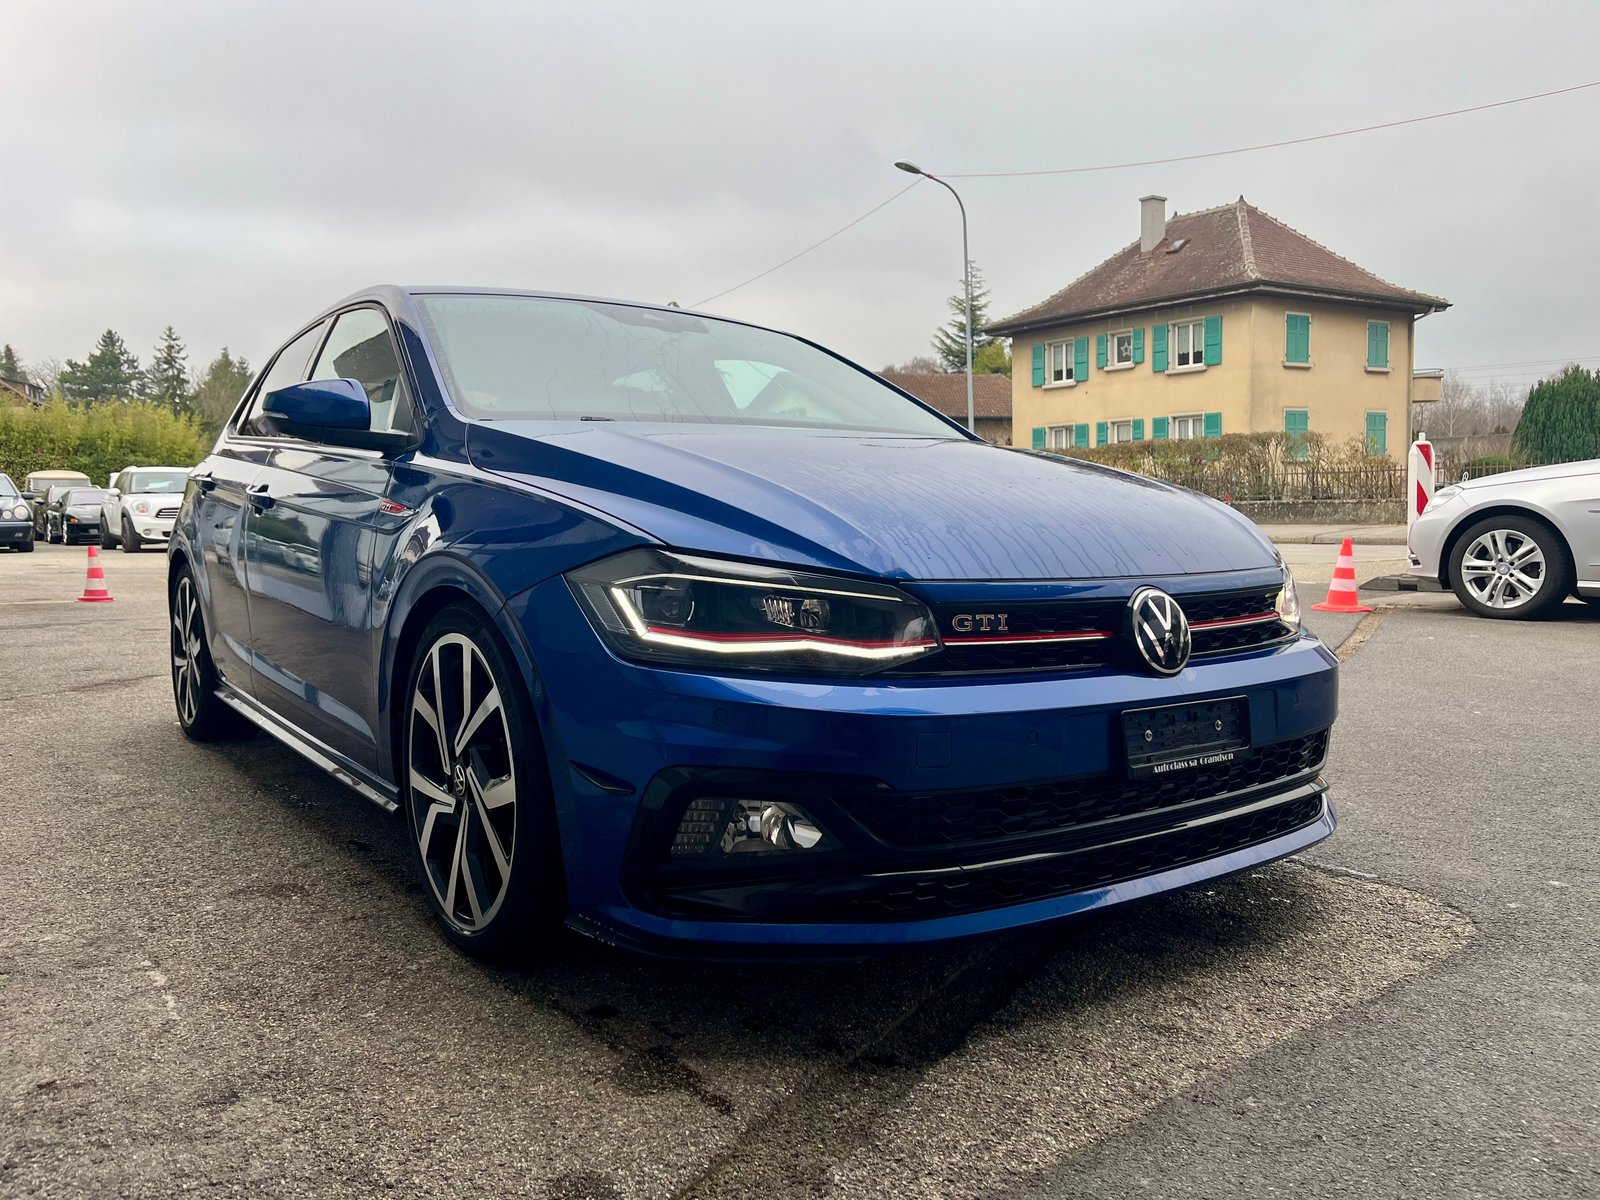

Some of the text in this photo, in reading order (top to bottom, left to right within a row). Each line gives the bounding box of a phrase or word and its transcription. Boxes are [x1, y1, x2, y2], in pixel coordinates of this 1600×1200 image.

[952, 613, 1009, 632] GTI
[1152, 752, 1234, 774] Autoclass sa Grandson
